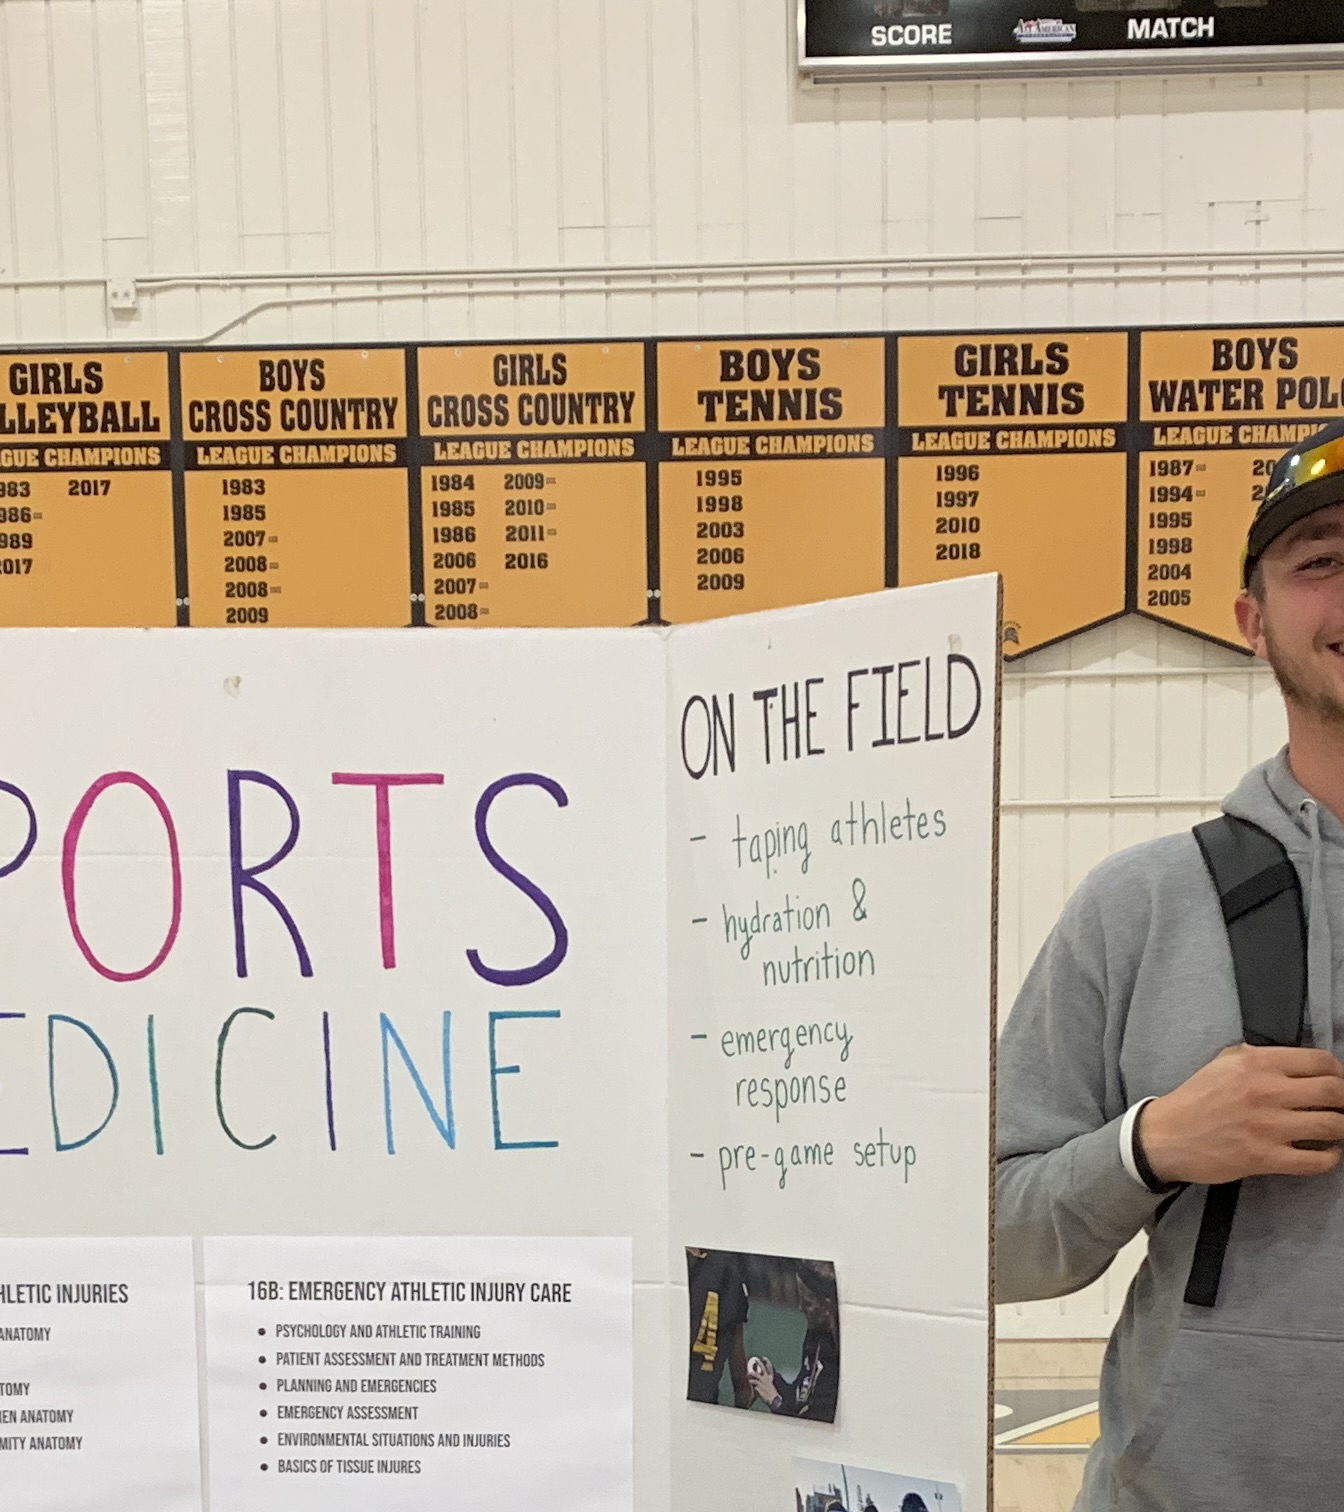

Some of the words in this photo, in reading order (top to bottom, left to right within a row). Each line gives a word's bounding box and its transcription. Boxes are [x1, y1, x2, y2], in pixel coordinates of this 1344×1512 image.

[870, 24, 953, 47] SCORE
[1127, 16, 1215, 41] MATCH
[493, 353, 567, 387] GIRLS
[720, 348, 820, 382] BOYS
[954, 342, 1069, 377] GIRLS
[1212, 337, 1298, 372] BOYS
[9, 362, 104, 396] GIRLS
[259, 359, 325, 392] BOYS
[427, 395, 509, 428] CROSS
[518, 392, 635, 426] COUNTRY
[698, 387, 843, 422] TENNIS
[939, 382, 1084, 417] TENNIS
[1148, 378, 1269, 413] WATER
[189, 400, 271, 433] CROSS
[280, 397, 398, 431] COUNTRY
[68, 480, 111, 497] 2017
[222, 479, 266, 495] 1983
[696, 470, 742, 486] 1995
[936, 544, 980, 560] 2018
[681, 693, 735, 780] ON
[753, 677, 825, 765] THE
[847, 653, 982, 752] FIELD
[732, 814, 812, 879] taping
[831, 798, 947, 846] athletes
[722, 894, 831, 960] hydration
[852, 878, 868, 921] &
[763, 941, 876, 987] nutrition
[721, 1018, 854, 1069] emergency
[736, 1073, 847, 1123] response
[719, 1144, 834, 1191] pre-game
[854, 1127, 917, 1184] setup
[56, 1284, 128, 1304] INJURIES
[248, 1281, 284, 1300] 16B:
[289, 1281, 386, 1301] EMERGENCY
[391, 1282, 465, 1302] ATHLETIC
[471, 1283, 525, 1302] INJURY
[530, 1283, 571, 1303] CARE
[276, 1352, 320, 1367] PATIENT
[324, 1353, 396, 1367] ASSESSMENT
[399, 1353, 422, 1367] AND
[425, 1353, 489, 1367] TREATMENT
[492, 1353, 545, 1368] METHODS
[278, 1433, 368, 1447] ENVIRONMENTAL
[372, 1433, 434, 1447] SITUATIONS
[437, 1433, 460, 1447] AND
[463, 1433, 510, 1448] INJURIES
[278, 1460, 317, 1474] BASICS
[320, 1460, 334, 1474] OF
[336, 1460, 374, 1474] TISSUE
[377, 1460, 421, 1474] INJURES
